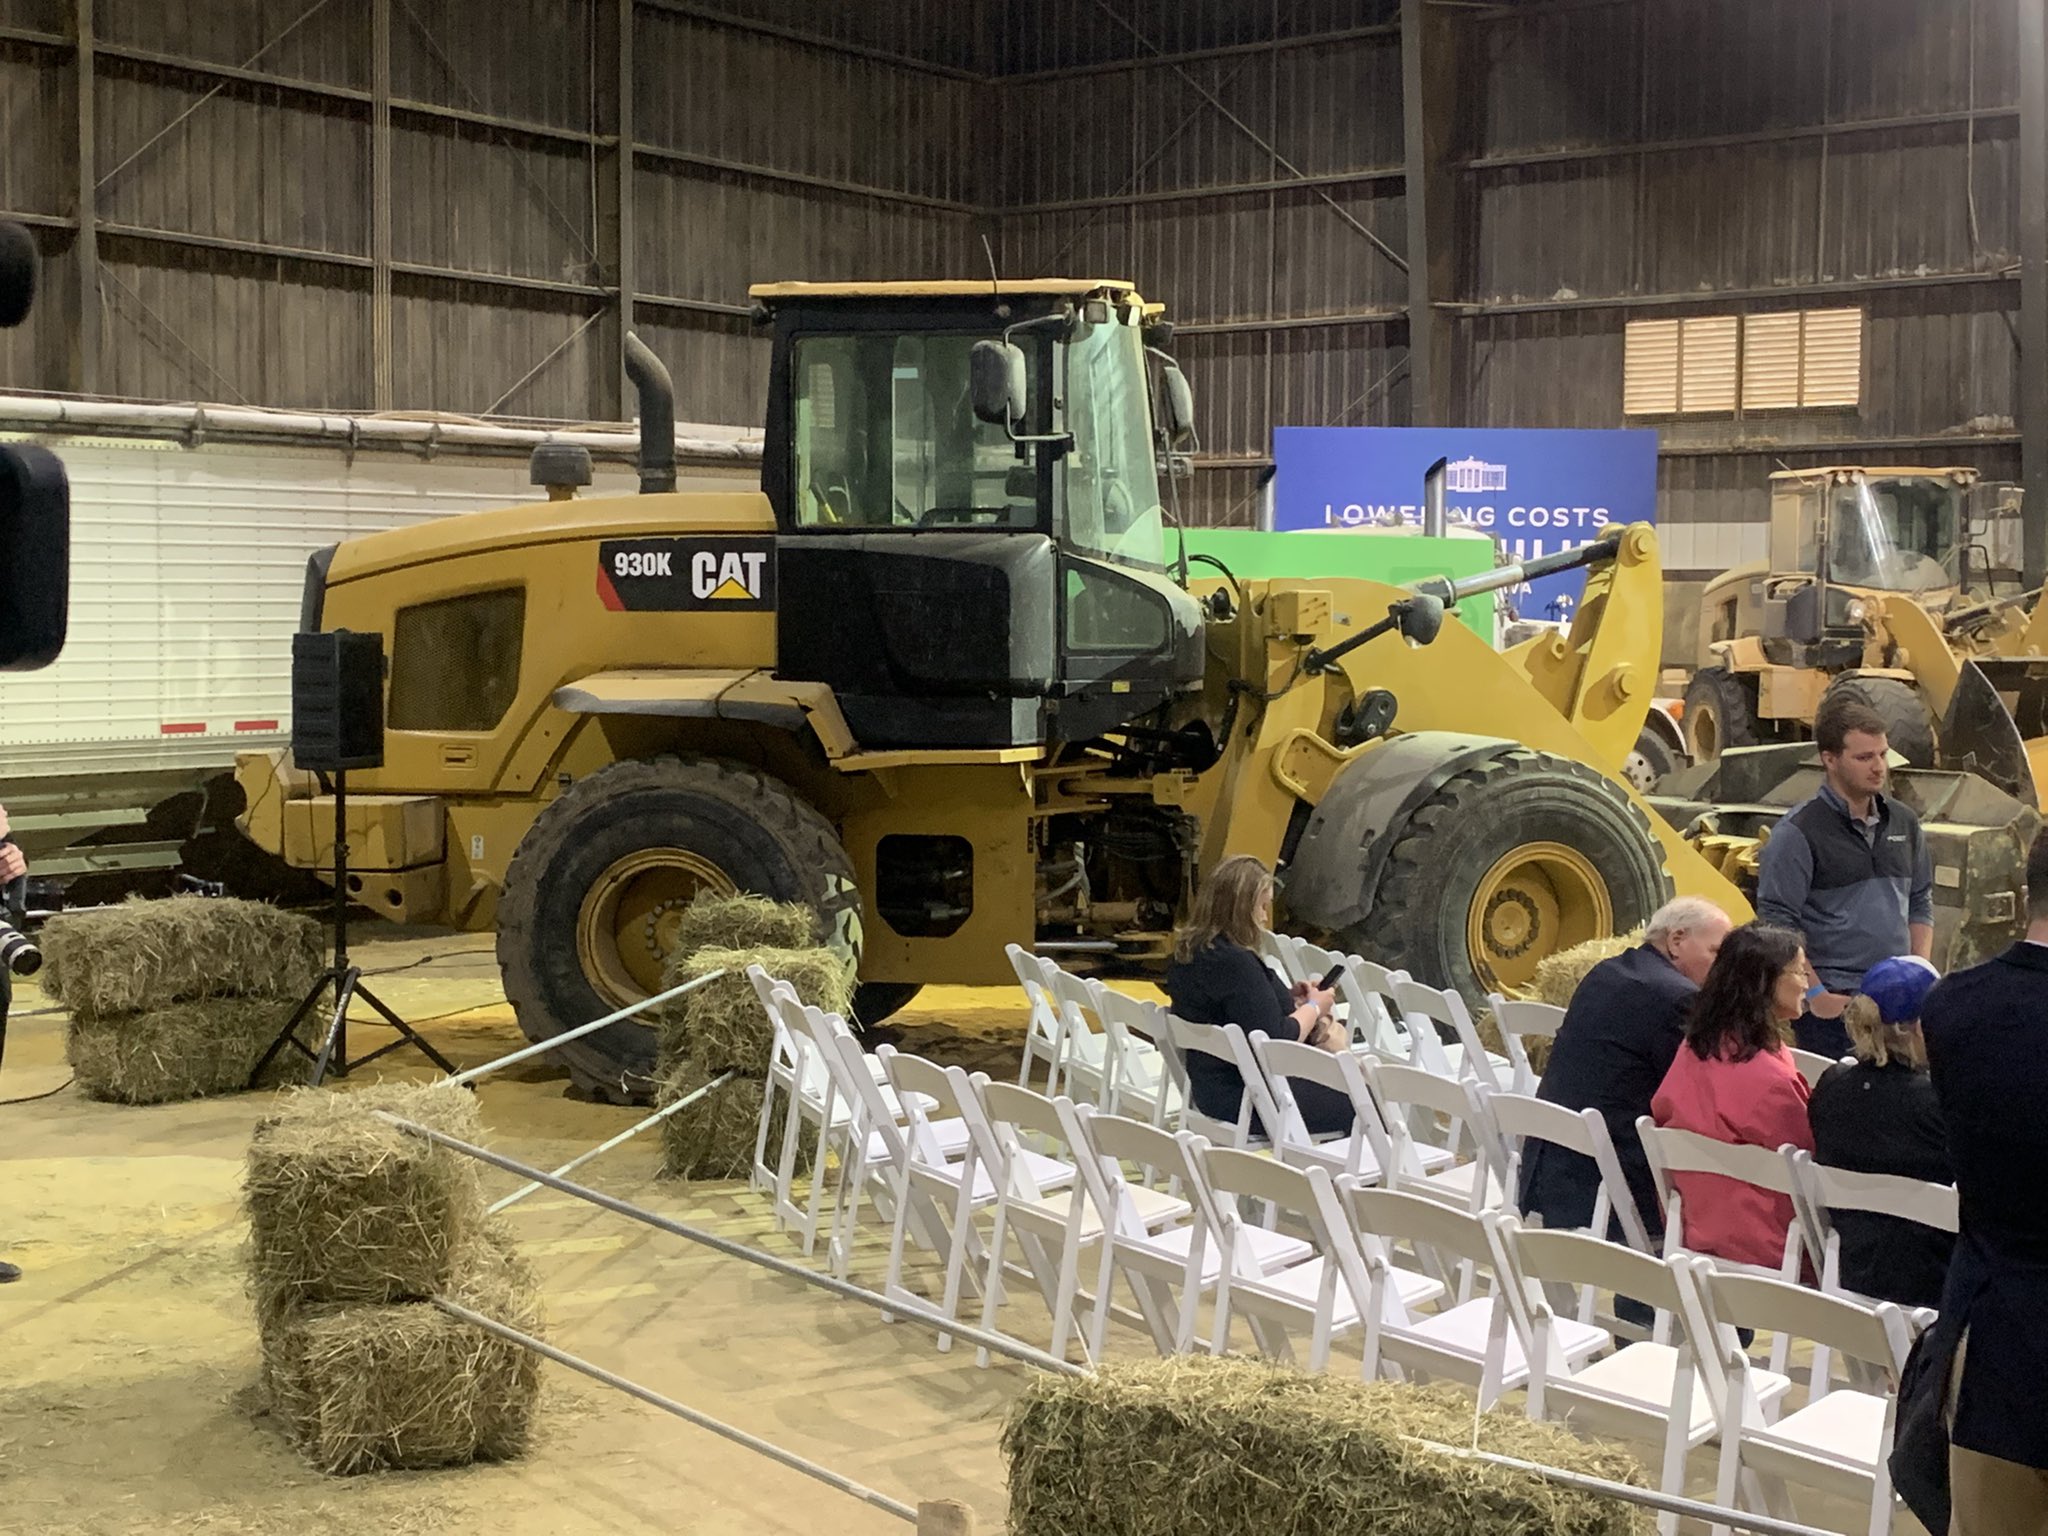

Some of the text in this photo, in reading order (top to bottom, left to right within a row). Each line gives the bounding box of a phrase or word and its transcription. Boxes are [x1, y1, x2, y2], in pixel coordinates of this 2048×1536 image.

[1508, 506, 1609, 528] COSTS
[614, 552, 673, 577] 930K
[691, 551, 767, 600] CAT
